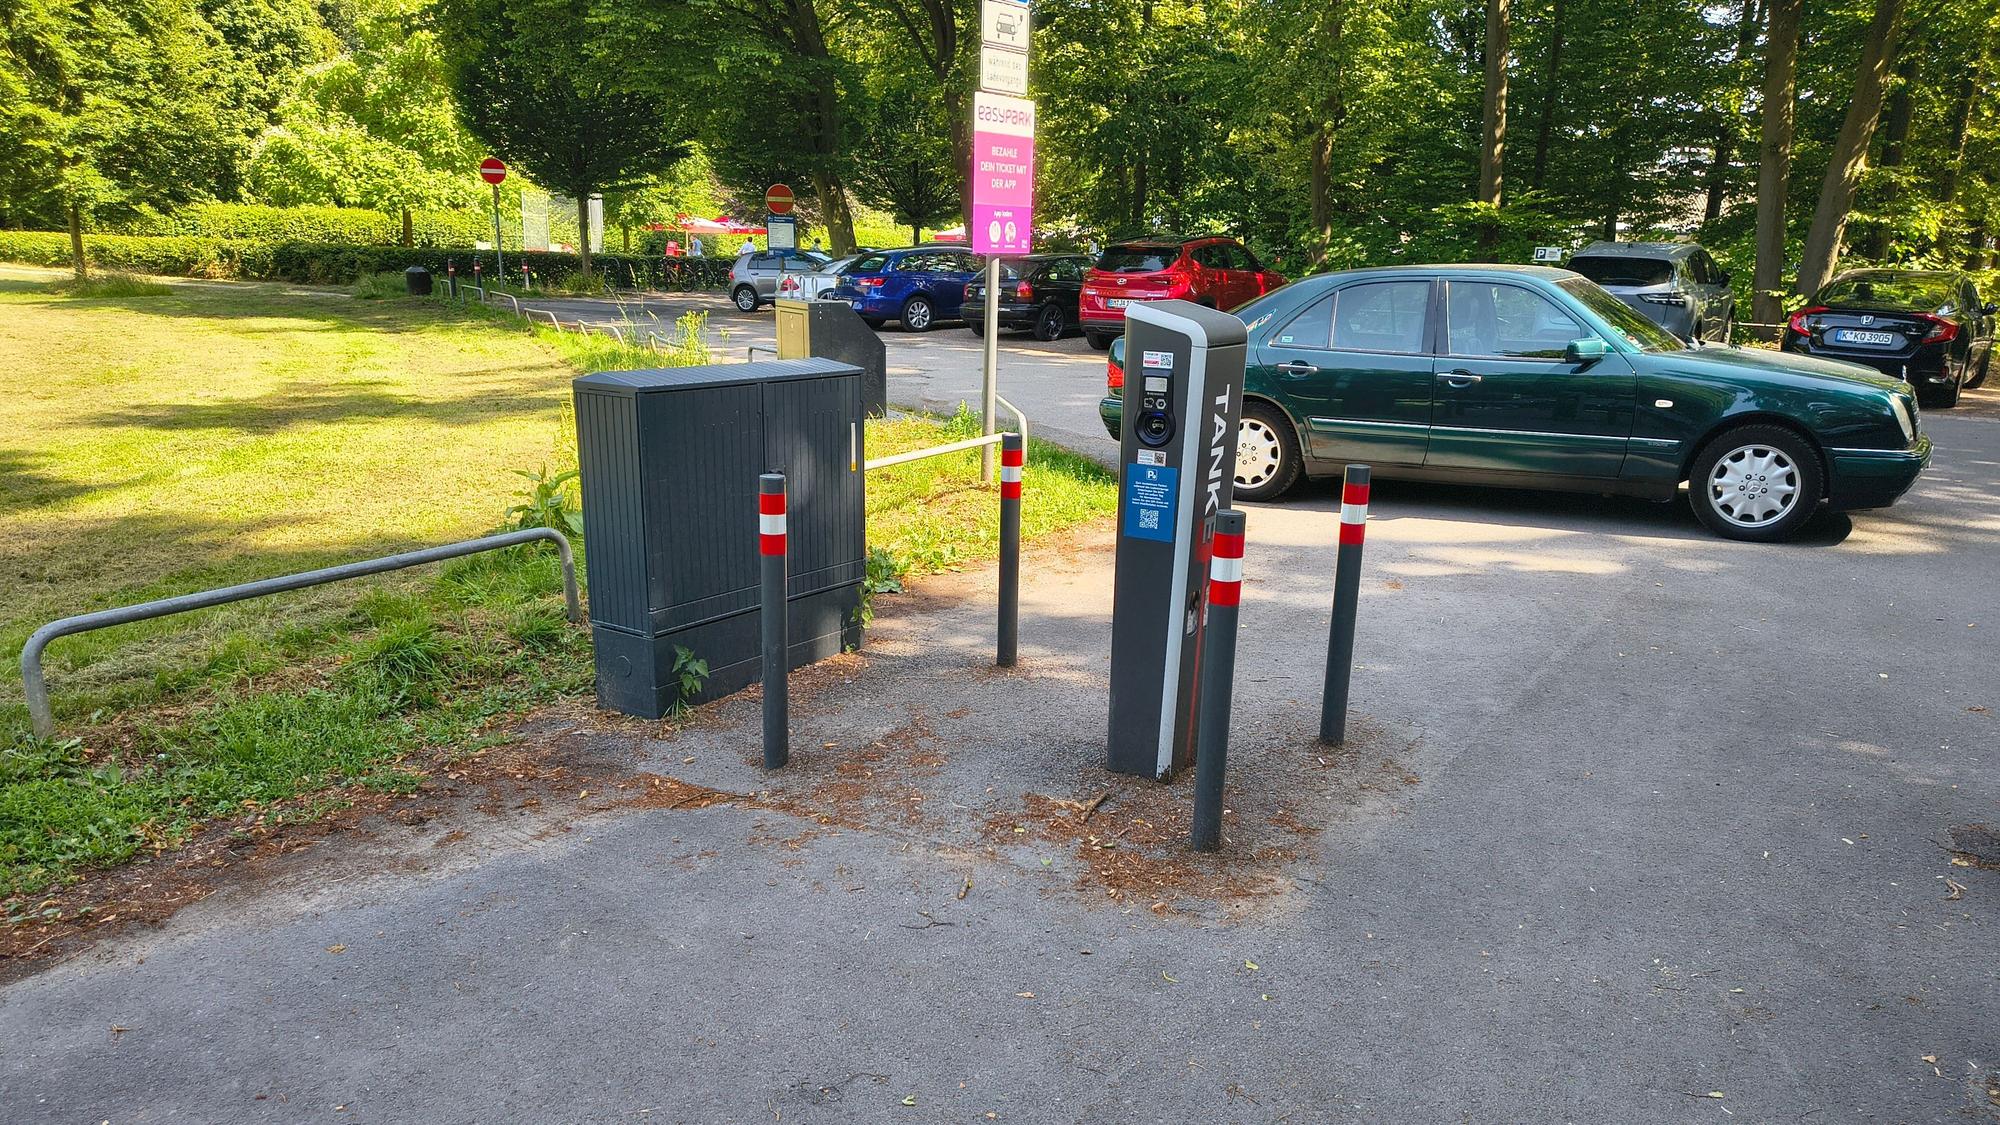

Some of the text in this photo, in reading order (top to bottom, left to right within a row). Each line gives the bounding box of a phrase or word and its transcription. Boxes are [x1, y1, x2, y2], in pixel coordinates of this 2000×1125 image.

[991, 146, 1018, 158] BEZAHLE
[980, 161, 1027, 176] DEIN TICKET MIT
[991, 178, 1017, 190] DER APP
[1841, 330, 1849, 340] K
[1867, 333, 1891, 343] 3905
